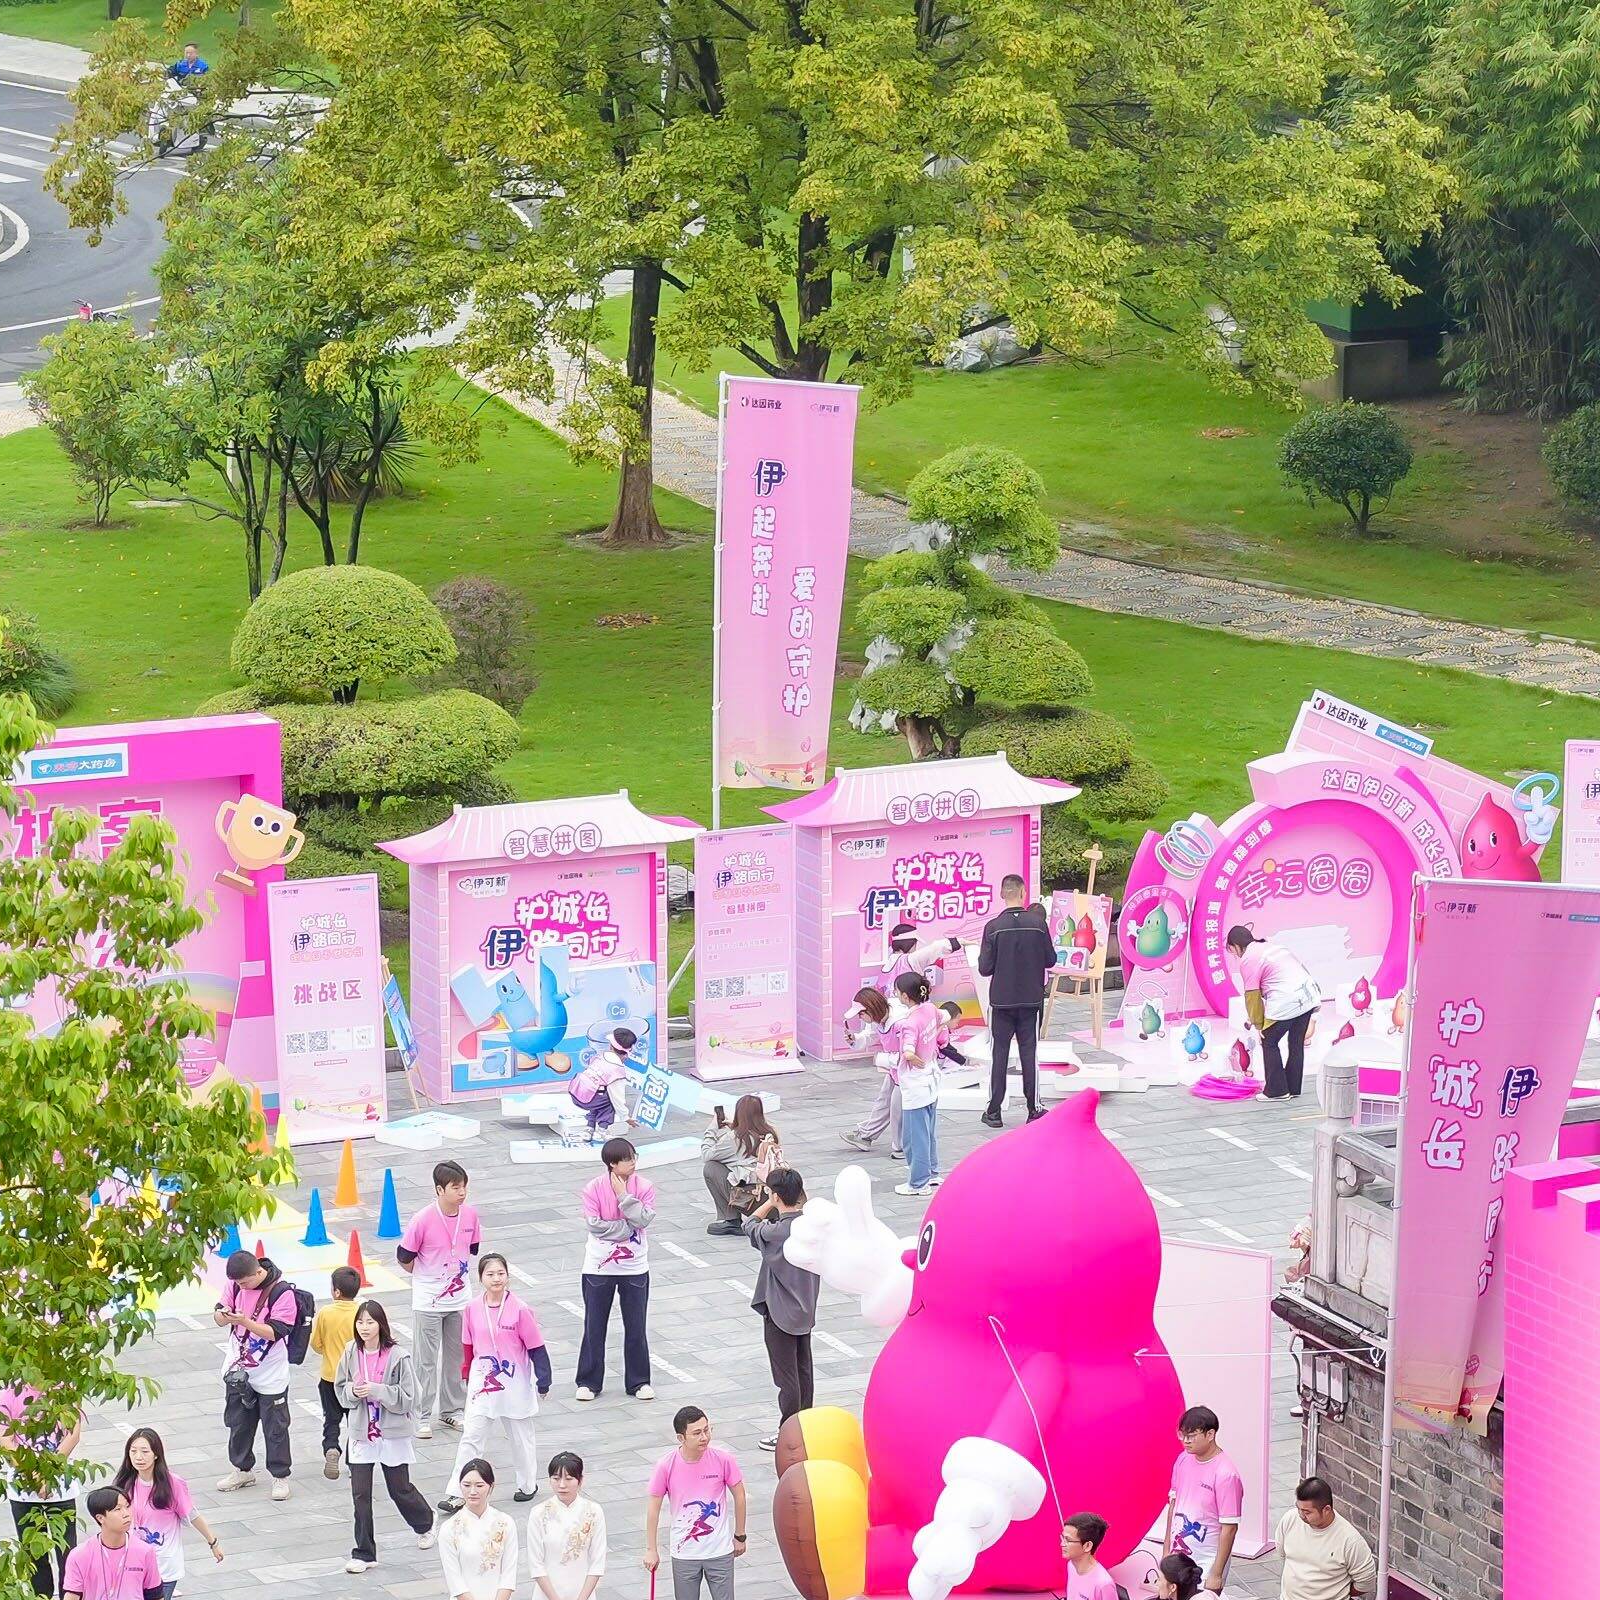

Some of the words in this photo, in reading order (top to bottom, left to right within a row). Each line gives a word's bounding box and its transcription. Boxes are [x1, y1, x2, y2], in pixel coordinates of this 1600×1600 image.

[750, 458, 788, 617] 伊起奔赴
[781, 565, 816, 717] 爱的守护
[1326, 701, 1369, 731] 达因药业
[891, 792, 975, 822] 智慧拼图
[1321, 768, 1417, 823] 达因伊可新
[508, 828, 596, 856] 智慧拼图
[723, 851, 768, 869] 护城长
[893, 852, 984, 890] 护城长
[715, 866, 775, 889] 伊路同行
[1234, 853, 1375, 911] 幸运圈圈
[299, 912, 349, 931] 护城长
[515, 891, 611, 930] 护城长
[861, 884, 992, 931] 伊路同行
[1446, 902, 1477, 914] 伊可新
[292, 930, 358, 951] 伊路同行
[293, 979, 363, 1006] 挑战区
[611, 1005, 626, 1016] Ca
[1421, 997, 1486, 1171] 护城长
